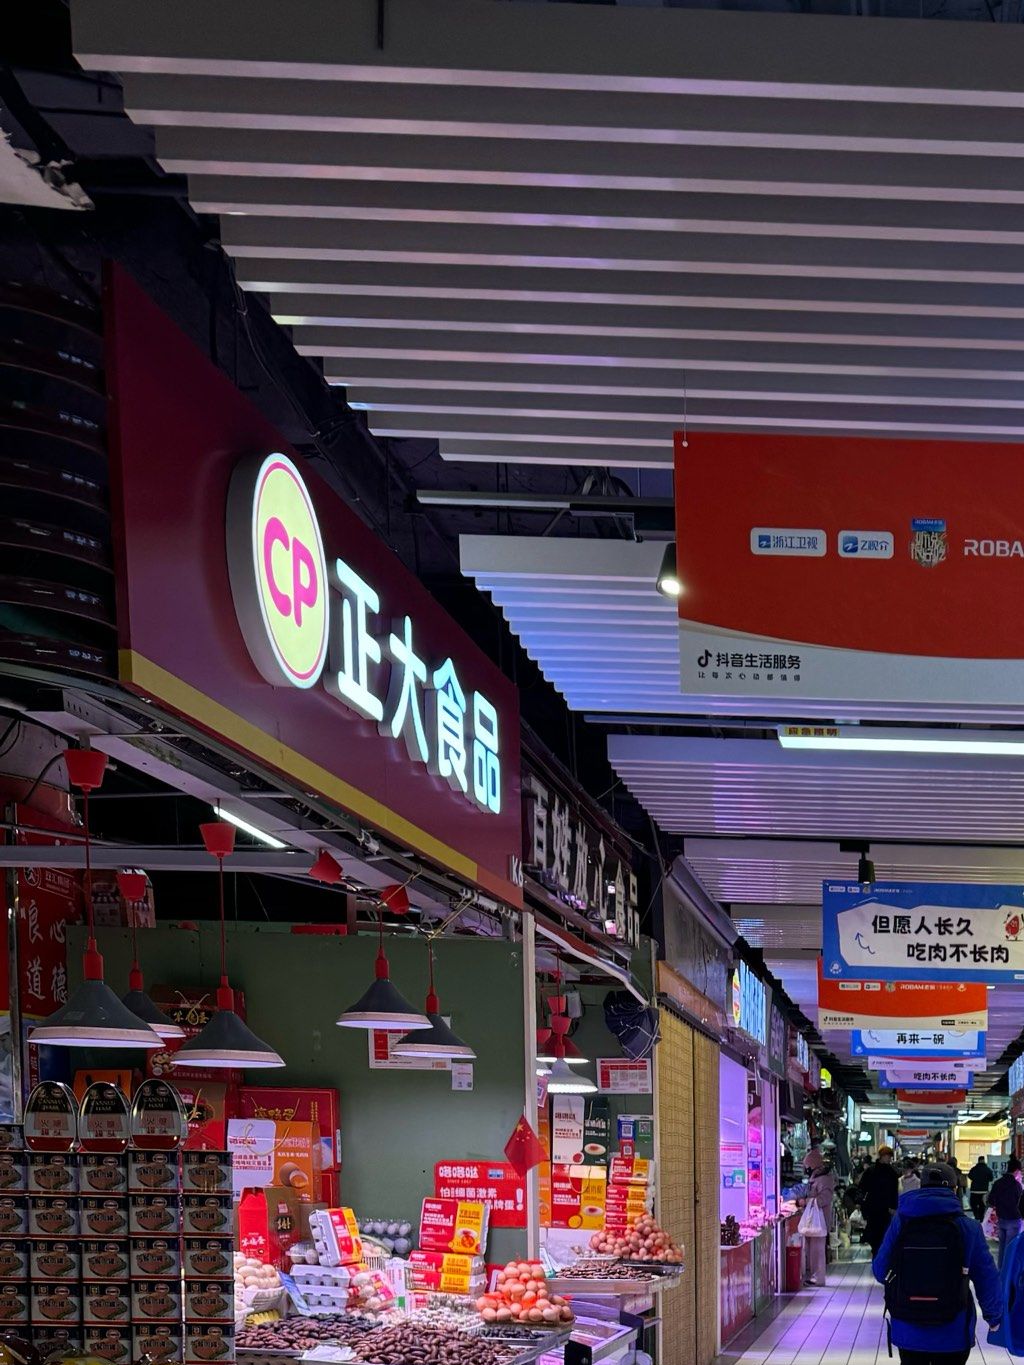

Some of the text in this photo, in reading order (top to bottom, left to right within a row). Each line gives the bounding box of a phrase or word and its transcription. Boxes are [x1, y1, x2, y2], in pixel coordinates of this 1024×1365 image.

[773, 535, 818, 549] 浙江卫视
[263, 517, 318, 628] CP
[716, 652, 801, 669] 抖音生活服务
[335, 557, 501, 815] 正大食品
[871, 914, 974, 936] 但愿人长久
[906, 942, 1010, 964] 吃肉不长肉
[895, 1032, 945, 1046] 再来一碗
[913, 1072, 957, 1082] 吃肉不长肉
